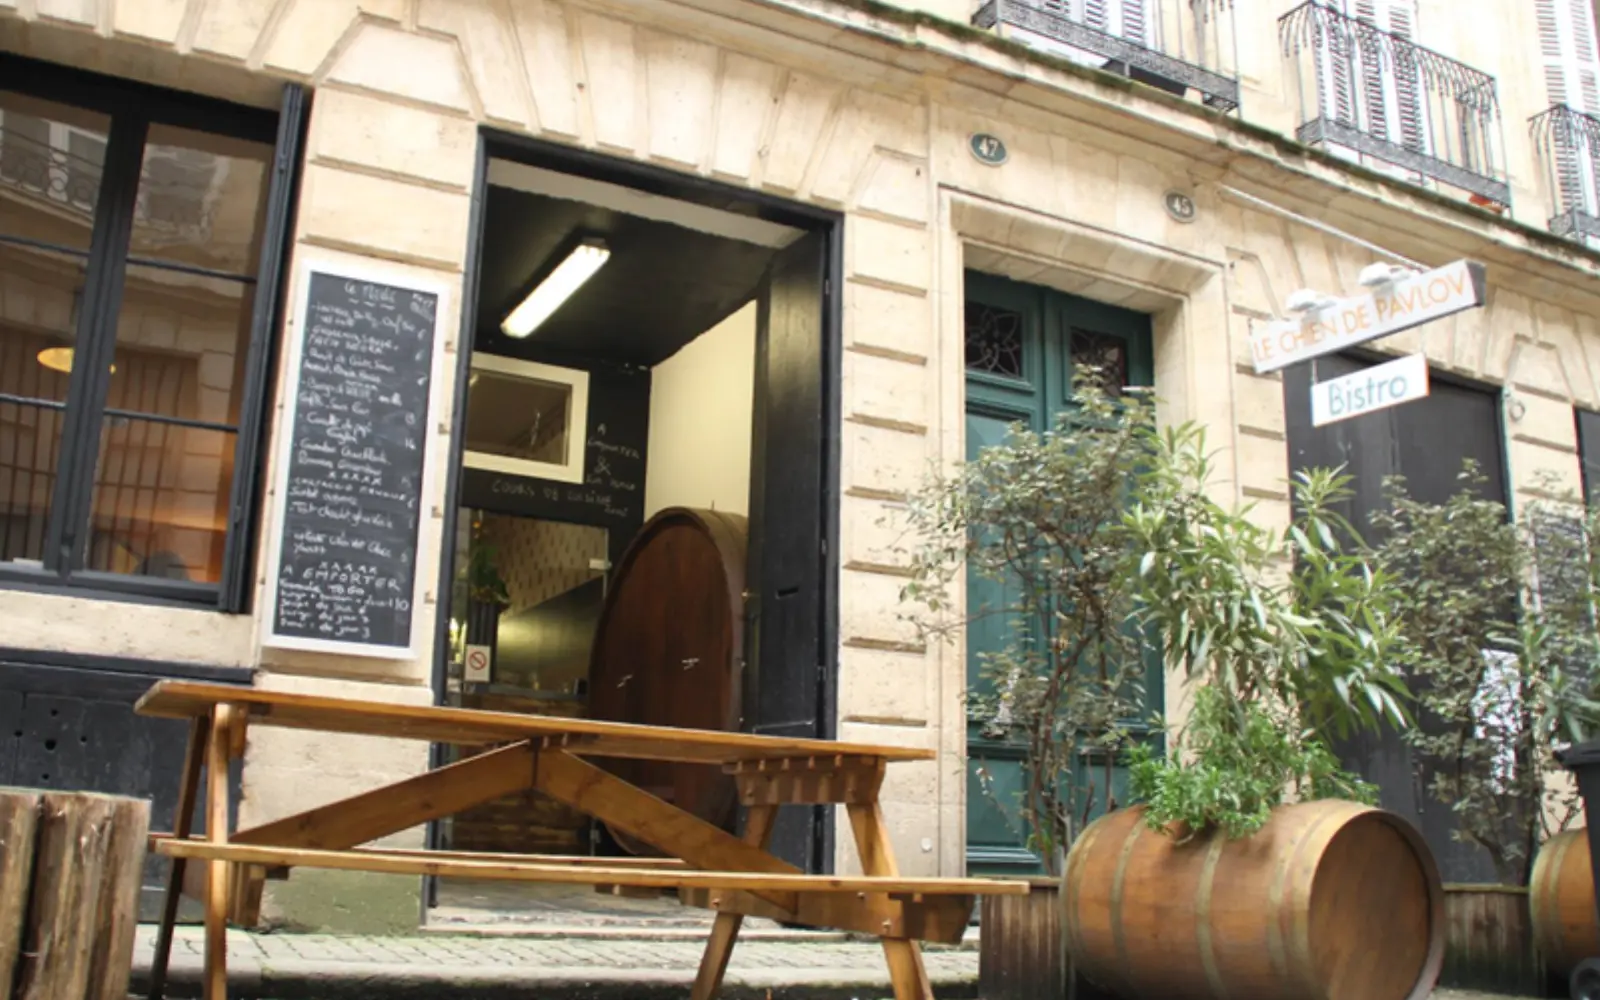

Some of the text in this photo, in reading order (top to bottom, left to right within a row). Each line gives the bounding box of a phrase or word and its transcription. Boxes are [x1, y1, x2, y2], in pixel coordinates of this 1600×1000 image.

[1253, 338, 1274, 362] LE
[1342, 307, 1371, 333] DE
[1374, 270, 1466, 322] PAVLOV
[1328, 375, 1408, 416] Bistro
